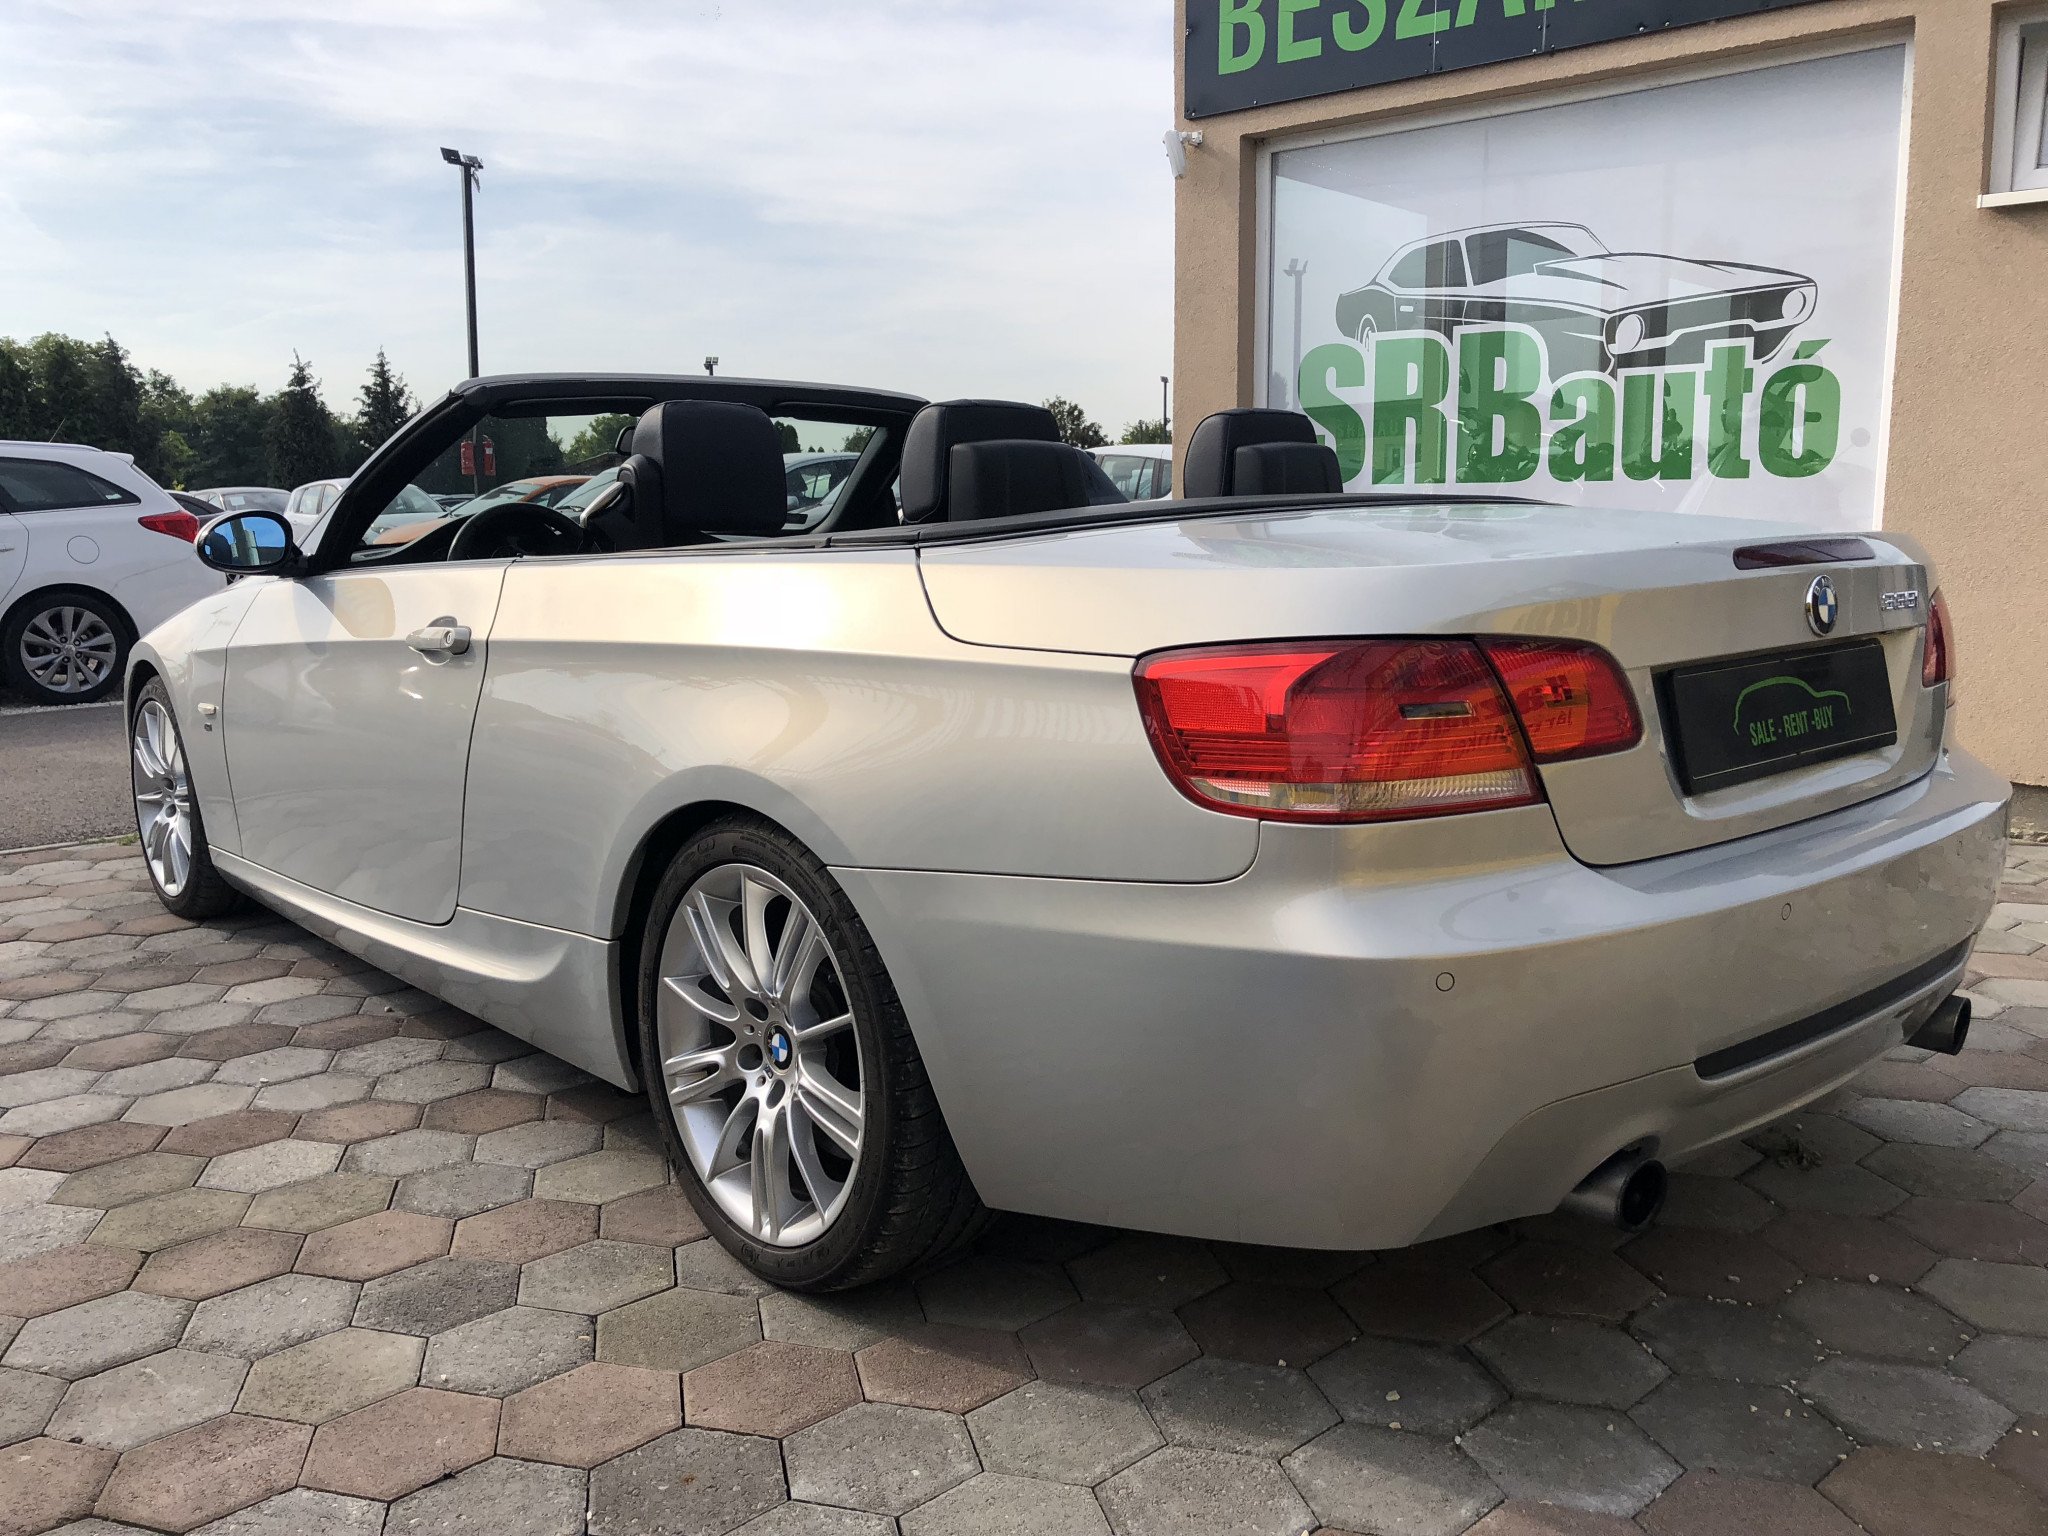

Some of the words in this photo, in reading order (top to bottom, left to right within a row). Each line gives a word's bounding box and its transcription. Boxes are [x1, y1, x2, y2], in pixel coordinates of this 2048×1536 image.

[1298, 330, 1841, 486] SRBautó
[1749, 718, 1777, 747] SALE
[1782, 710, 1809, 738] RENT
